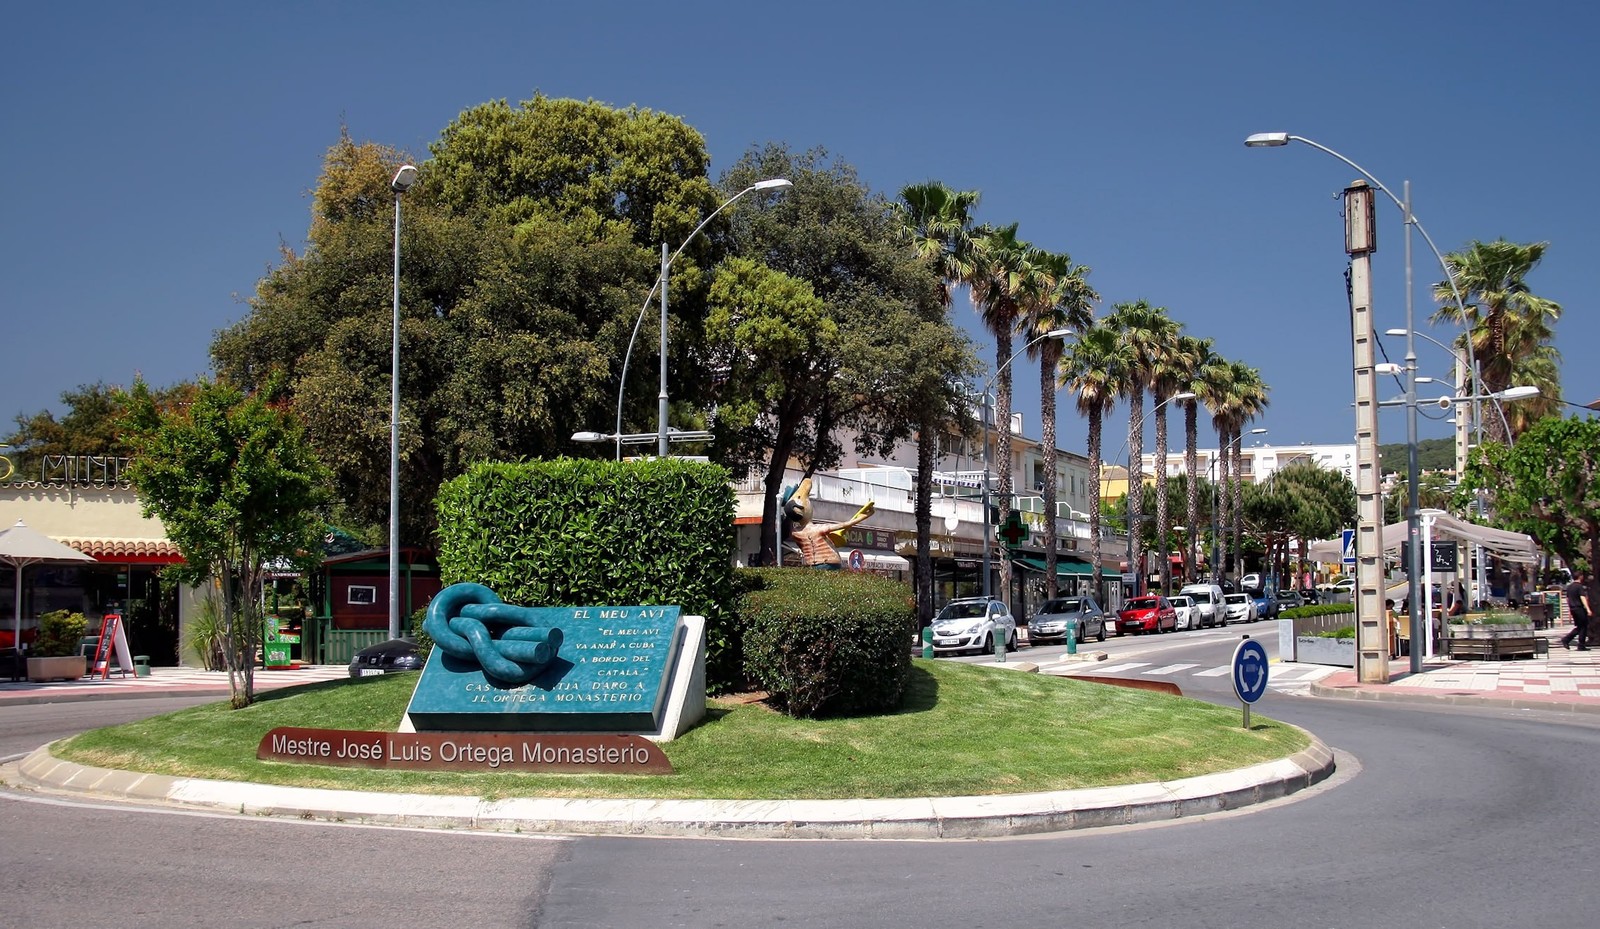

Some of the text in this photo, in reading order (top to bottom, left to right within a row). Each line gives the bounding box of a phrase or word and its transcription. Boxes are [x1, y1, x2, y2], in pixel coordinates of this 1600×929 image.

[574, 609, 664, 619] EL MEU AVI
[493, 694, 546, 703] ORTEGA
[555, 693, 642, 702] MONASTERIO
[272, 734, 649, 767] Mestre José Luis Ortega Monasterio
